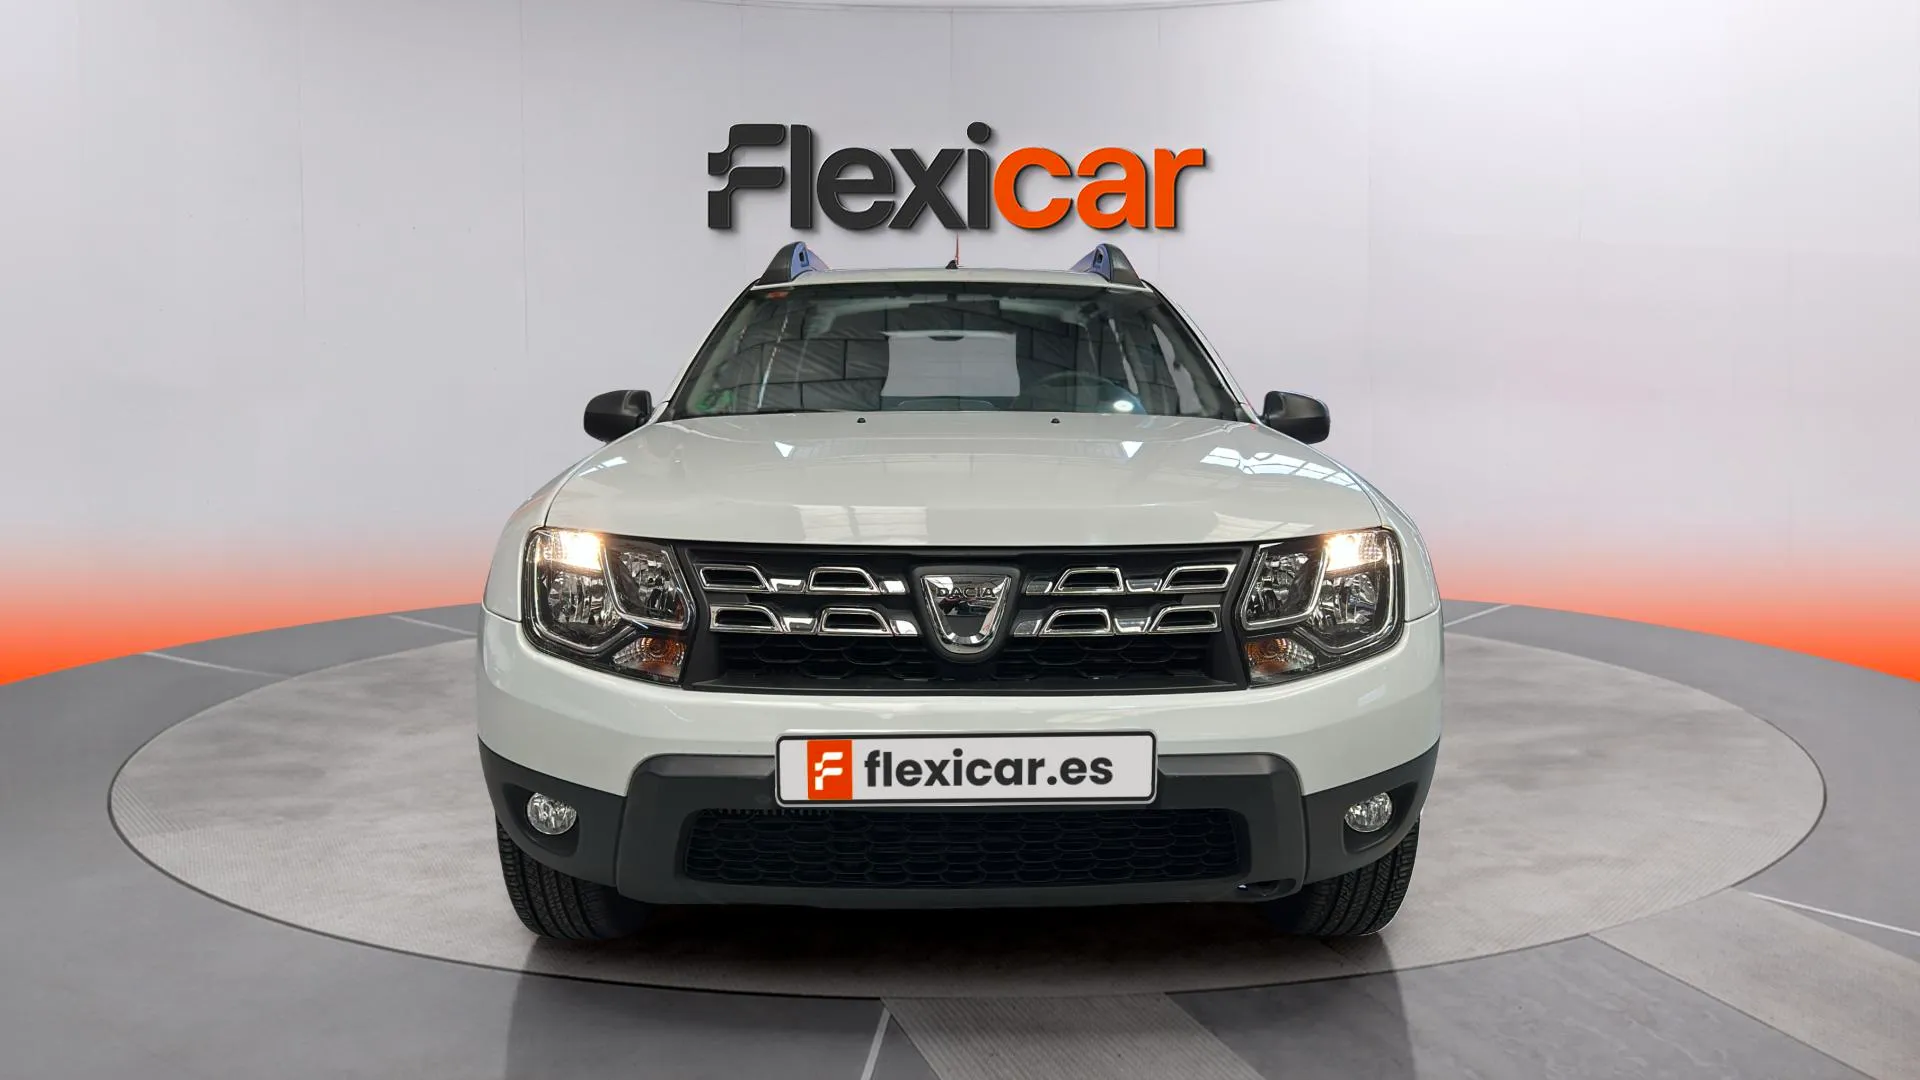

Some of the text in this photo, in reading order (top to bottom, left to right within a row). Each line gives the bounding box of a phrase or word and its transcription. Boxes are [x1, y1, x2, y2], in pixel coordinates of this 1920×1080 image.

[708, 121, 1205, 229] Flexicar
[936, 587, 996, 598] DACIA
[864, 748, 1114, 787] flexicar.es
